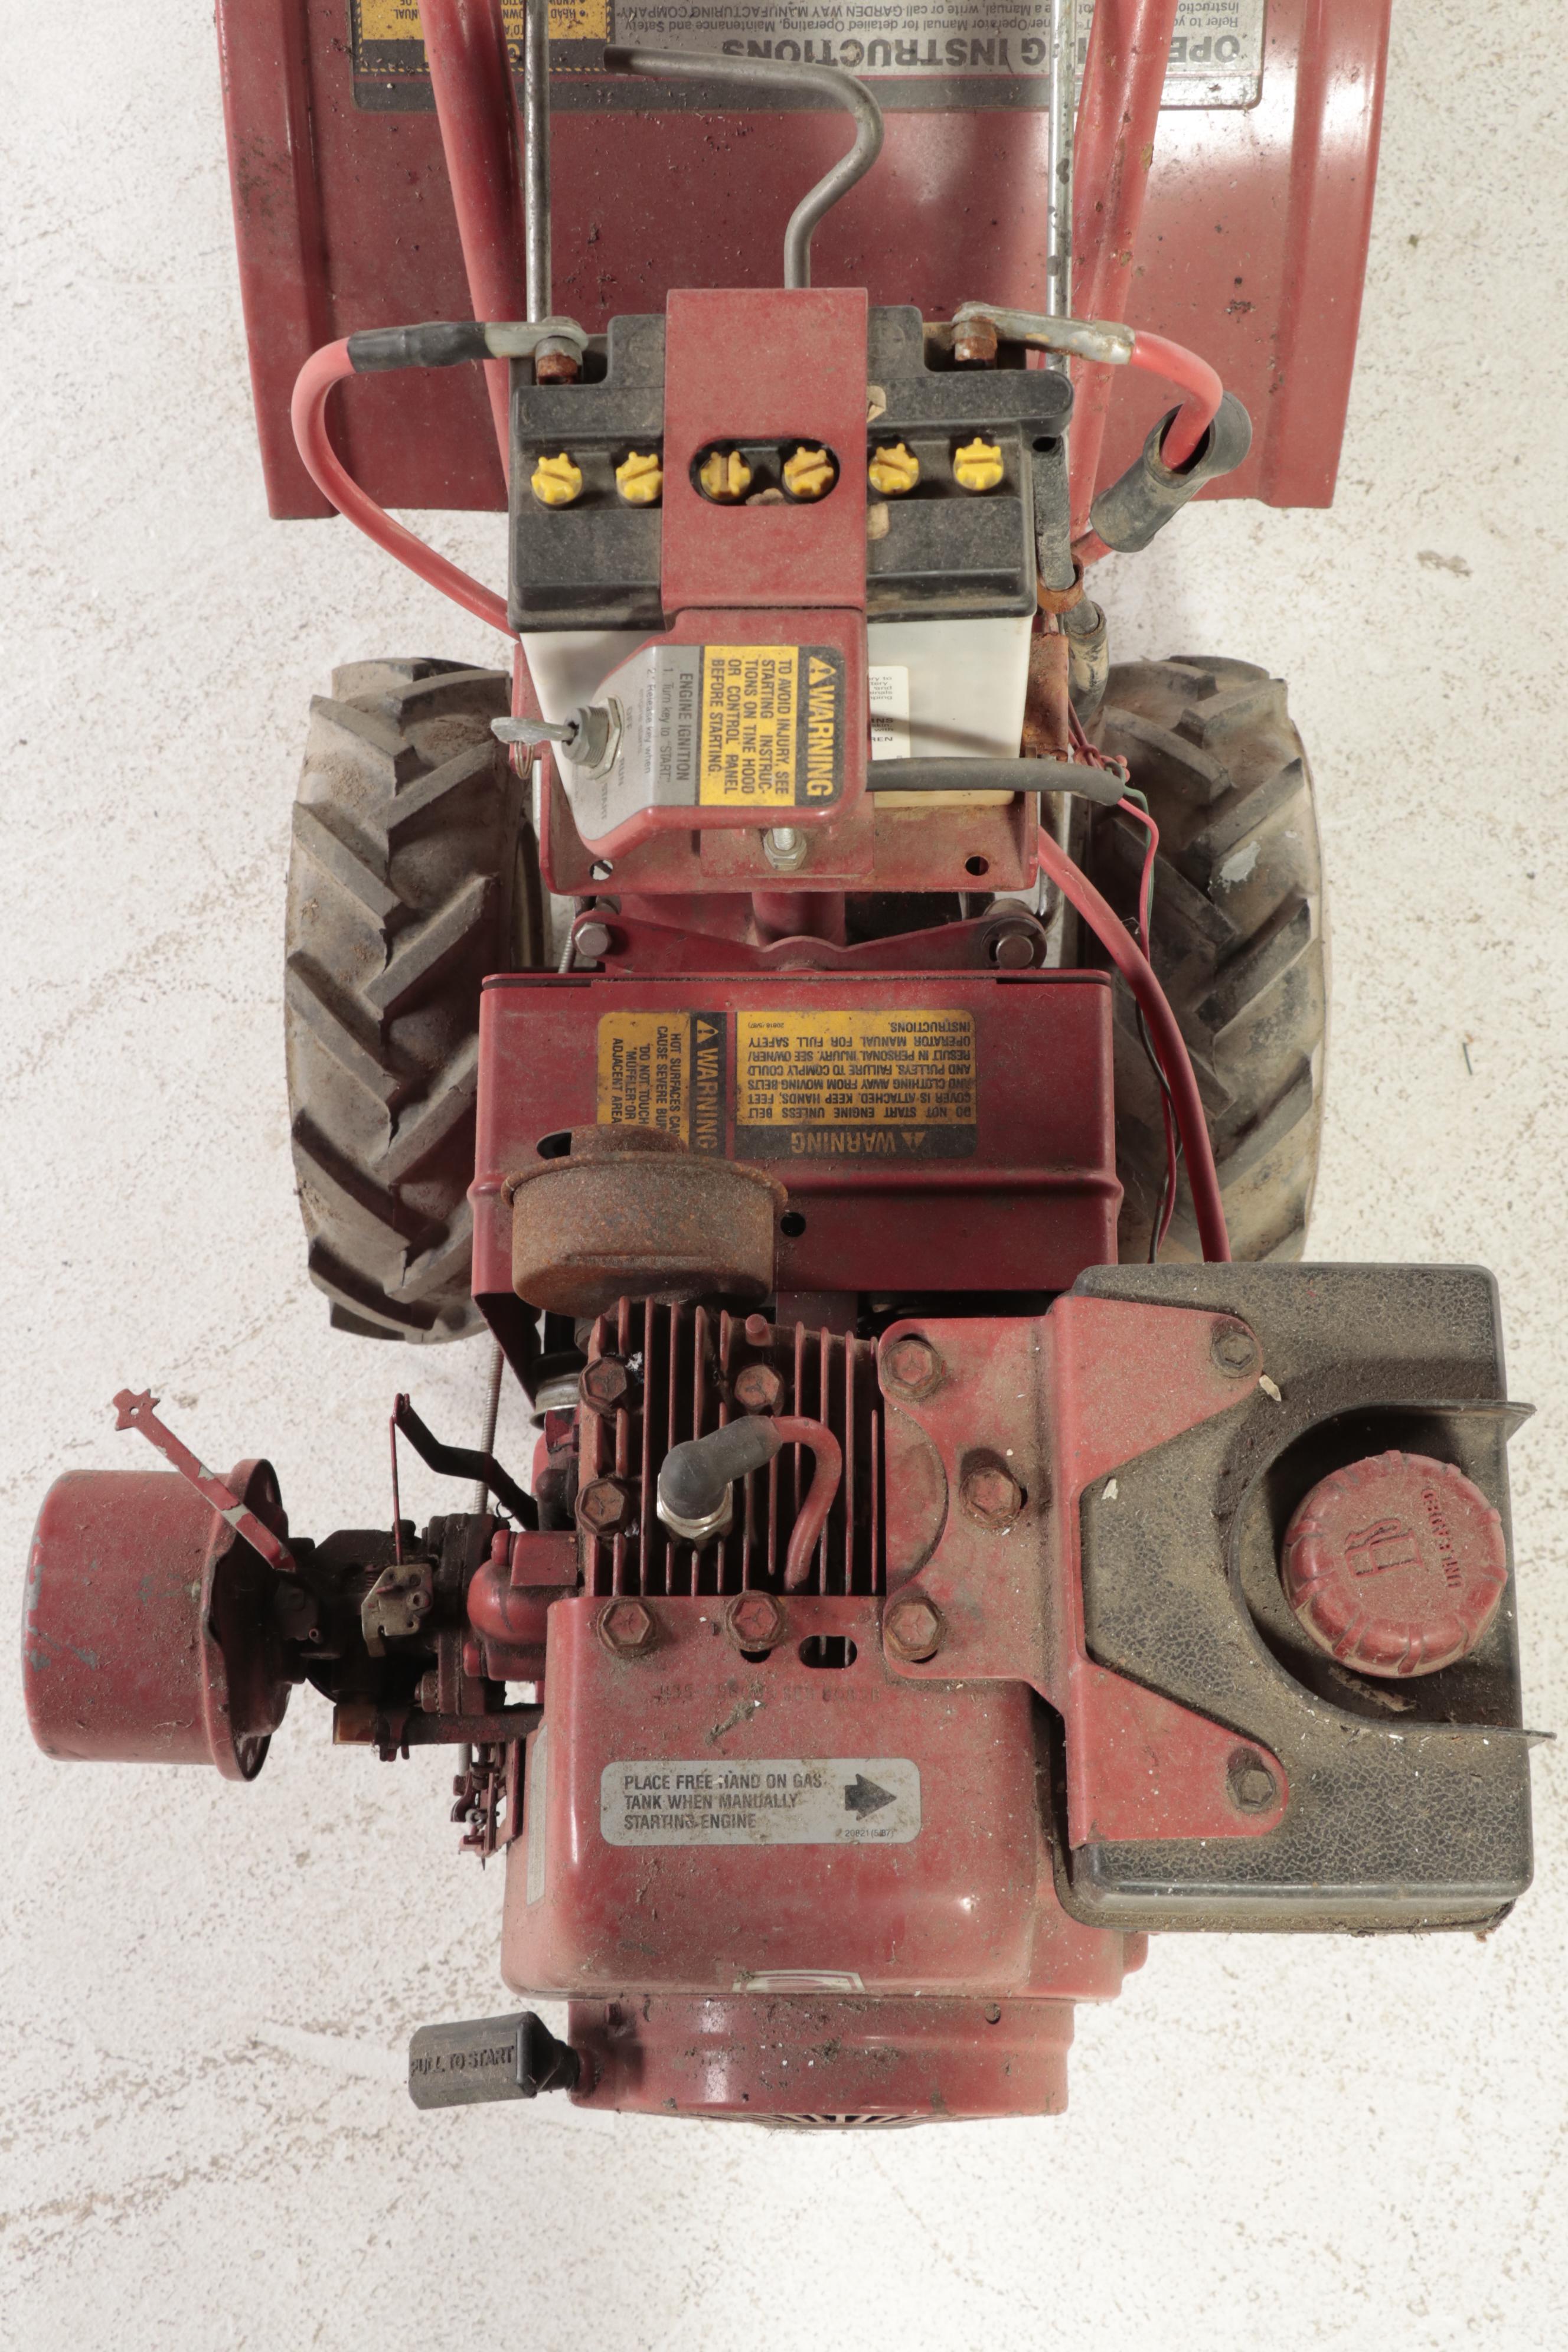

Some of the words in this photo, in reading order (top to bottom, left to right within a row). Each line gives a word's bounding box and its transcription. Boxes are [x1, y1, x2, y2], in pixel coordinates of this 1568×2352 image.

[623, 5, 688, 18] COMPANY
[690, 5, 809, 18] MANUFACTURING
[812, 5, 842, 17] WAY
[846, 5, 903, 17] GARDEN
[906, 5, 927, 17] call
[931, 5, 944, 14] or
[947, 5, 979, 17] write
[984, 3, 1031, 16] Manual,
[1034, 4, 1042, 13] a
[1177, 2, 1239, 15] Instructio
[625, 19, 665, 32] Safety
[668, 21, 692, 32] and
[695, 20, 776, 32] Maintenance
[779, 18, 845, 32] Operating,
[849, 19, 899, 32] detailed
[902, 19, 920, 31] for
[923, 19, 968, 31] Manual
[972, 17, 1051, 30] ner/Operator
[1190, 17, 1202, 27] to
[1206, 17, 1239, 28] Refer
[721, 38, 1009, 67] INSTRUCTIONS
[1021, 35, 1240, 66] OPEIG
[728, 659, 741, 676] OR
[778, 659, 792, 674] TO
[710, 659, 724, 707] BEFORE
[744, 659, 758, 696] TIONS
[662, 683, 674, 703] Turn
[760, 659, 775, 719] STARTING
[678, 673, 693, 719] ENGINE
[778, 678, 791, 714] AVOID
[645, 684, 656, 723] Release
[743, 701, 757, 719] ON
[659, 707, 672, 723] key
[726, 685, 741, 744] CONTROL
[643, 726, 654, 743] key
[661, 727, 671, 736] to
[708, 712, 723, 776] STARTING.
[742, 725, 756, 753] TINE
[775, 718, 790, 766] INJURY,
[806, 684, 835, 796] WARNING
[676, 725, 691, 780] IGNITION
[643, 747, 653, 774] when
[759, 735, 773, 794] INSTRUC-
[724, 754, 739, 795] PANEL
[741, 759, 755, 794] HOOD
[775, 771, 789, 795] SEE
[888, 1021, 971, 1033] INSTRUCTIONS.
[656, 1026, 668, 1060] CAUSE
[670, 1033, 681, 1053] HOT
[749, 1037, 789, 1047] SAFETY
[796, 1037, 823, 1047] FULL
[831, 1037, 852, 1047] FOR
[860, 1036, 907, 1047] MANUAL
[913, 1035, 971, 1047] OPERATOR
[639, 1046, 651, 1061] DO
[748, 1050, 792, 1061] OWNER/
[795, 1050, 814, 1061] SEE
[817, 1050, 856, 1061] INJURY.
[859, 1050, 914, 1061] PERSONAL
[919, 1050, 929, 1061] IN
[932, 1050, 971, 1061] RESULT
[612, 1038, 623, 1092] ADJACENT
[747, 1065, 784, 1076] COULD
[787, 1064, 830, 1076] COMPLY
[832, 1064, 845, 1075] TO
[848, 1064, 892, 1075] FAILURE
[896, 1064, 945, 1075] PULLEYS.
[948, 1064, 971, 1074] AND
[625, 1051, 636, 1102] MUFFLER
[639, 1064, 651, 1085] NOT
[656, 1064, 668, 1104] SEVERE
[669, 1057, 681, 1112] SURFACES
[748, 1079, 778, 1090] BELTS
[781, 1079, 823, 1090] MOVING
[827, 1079, 858, 1090] FROM
[861, 1079, 889, 1089] AWAY
[893, 1078, 945, 1089] CLOTHING
[948, 1078, 971, 1089] AND
[695, 1047, 718, 1149] WARNING
[748, 1093, 774, 1104] FEET
[779, 1092, 821, 1104] HANDS,
[825, 1093, 852, 1104] KEEP
[858, 1093, 916, 1104] ATTACHED.
[920, 1093, 930, 1103] IS
[935, 1092, 971, 1103] COVER
[625, 1105, 636, 1120] OR
[638, 1090, 650, 1125] TOUCH
[748, 1108, 773, 1119] BELT
[782, 1107, 825, 1118] UNLESS
[834, 1107, 875, 1118] ENGINE
[883, 1107, 916, 1118] START
[926, 1107, 947, 1118] NOT
[956, 1106, 971, 1118] DO
[669, 1116, 681, 1137] CAN
[790, 1131, 896, 1154] WARNING
[1420, 1487, 1464, 1588] UNLEADED
[625, 1775, 671, 1790] PLACE
[677, 1775, 713, 1789] FREE
[718, 1773, 761, 1789] HAND
[766, 1773, 786, 1788] ON
[793, 1773, 822, 1788] GAS
[624, 1794, 662, 1809] TANK
[668, 1794, 713, 1809] WHEN
[718, 1794, 798, 1809] MANUALLY
[624, 1814, 695, 1830] STARTING
[701, 1814, 756, 1829] ENGINE
[411, 2055, 446, 2076] PULL
[449, 2053, 465, 2070] TO
[468, 2045, 515, 2067] START
